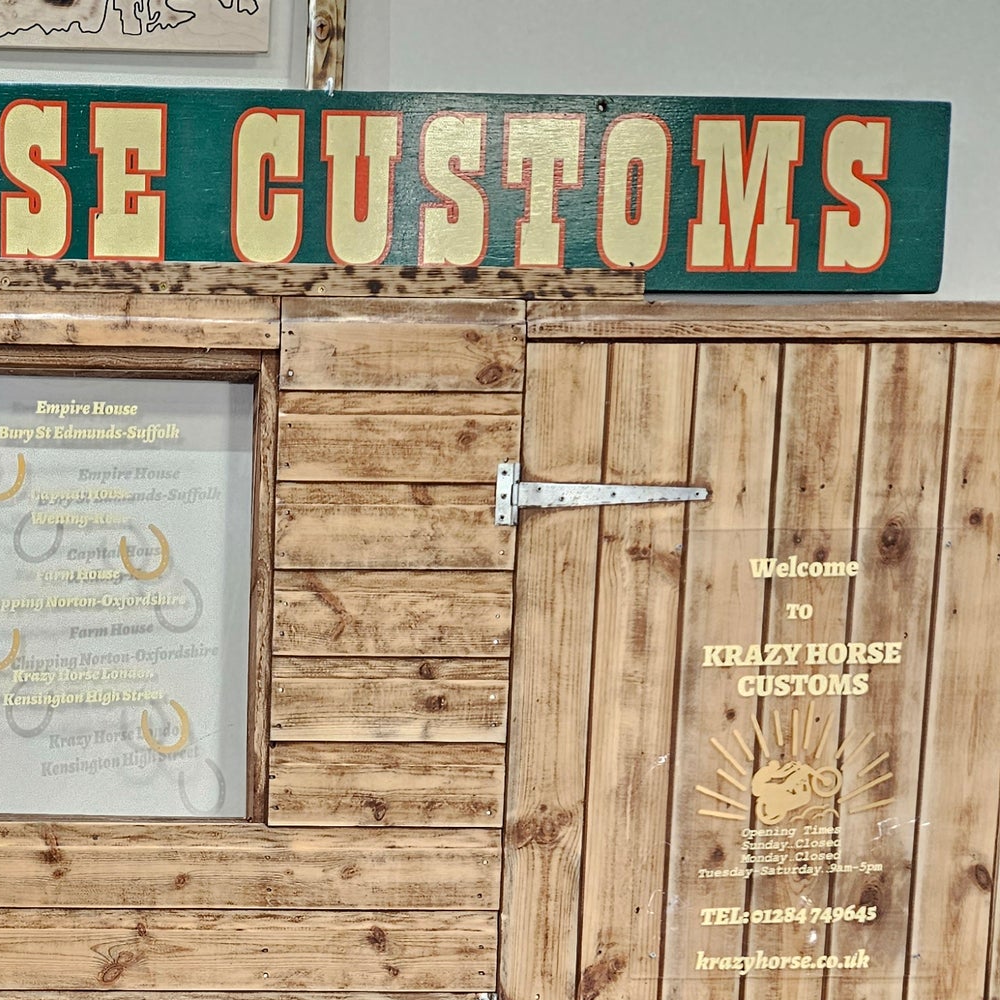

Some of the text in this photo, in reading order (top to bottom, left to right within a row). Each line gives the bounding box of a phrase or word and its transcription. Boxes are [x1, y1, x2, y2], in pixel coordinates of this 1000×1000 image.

[231, 107, 892, 274] CUSTOMS
[35, 399, 138, 420] Empire House
[35, 425, 52, 439] St
[53, 423, 180, 443] Edmunds-Suffolk
[749, 555, 860, 579] Welcome
[702, 641, 902, 667] KRAZY HORSE
[12, 668, 55, 685] Krazy
[57, 668, 99, 681] Horse
[737, 673, 869, 697] CUSTOMS
[2, 689, 85, 708] Kensington
[86, 689, 122, 705] High
[741, 825, 841, 839] Opening Times
[809, 905, 878, 925] 749645
[695, 949, 870, 976] krazyhorse.co.uk
